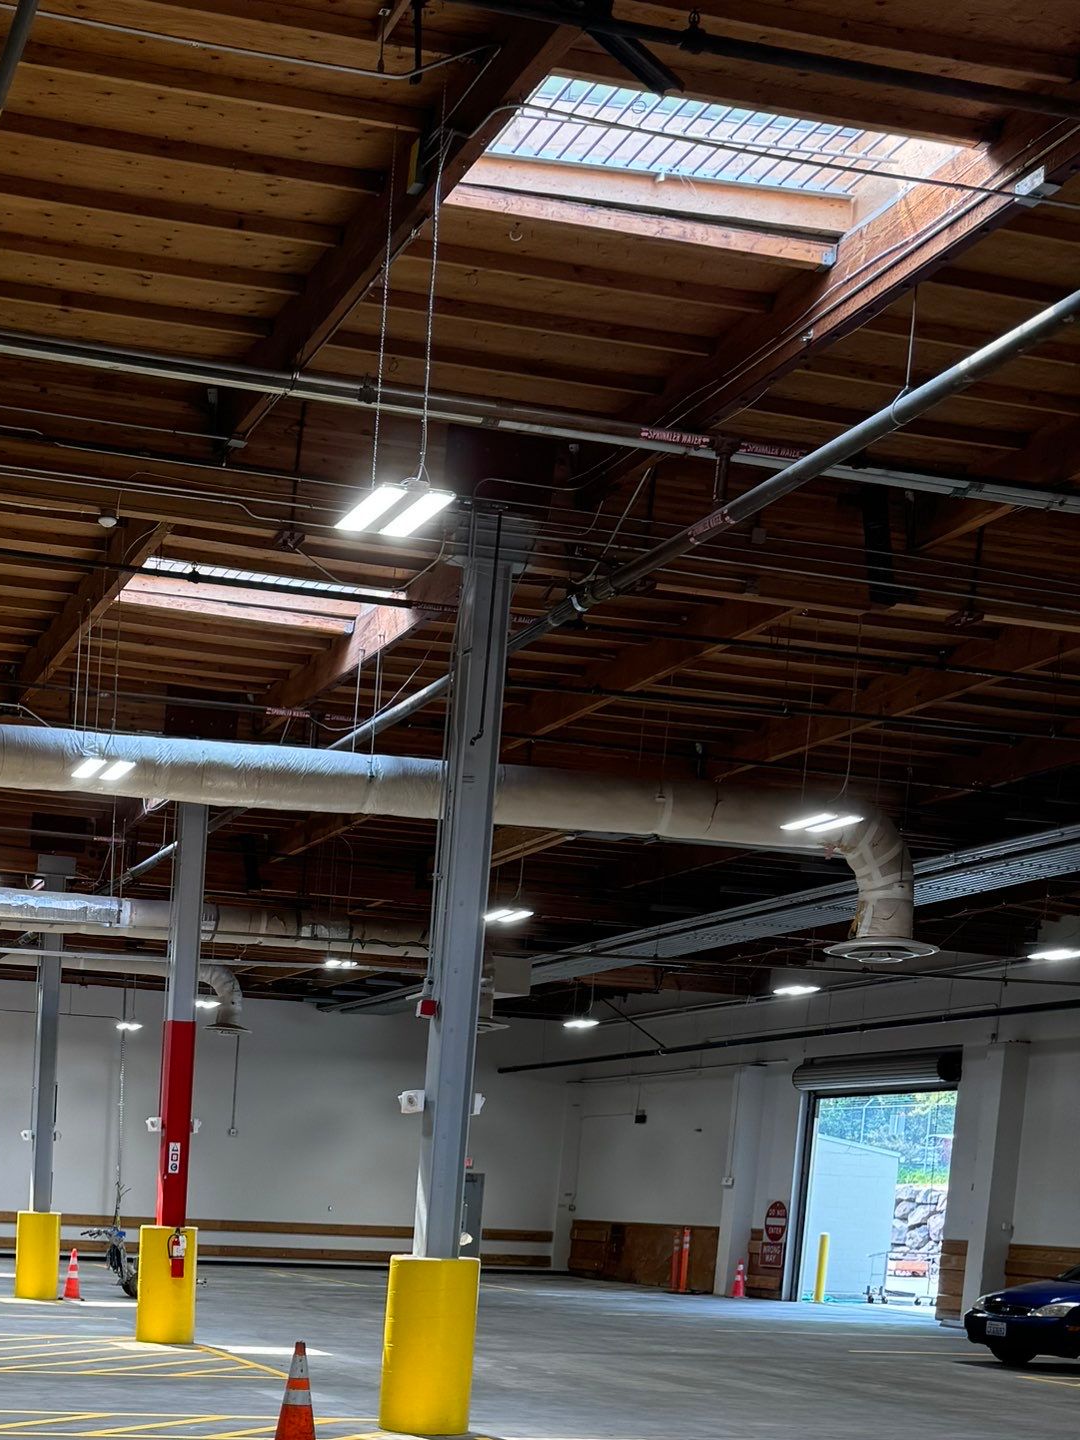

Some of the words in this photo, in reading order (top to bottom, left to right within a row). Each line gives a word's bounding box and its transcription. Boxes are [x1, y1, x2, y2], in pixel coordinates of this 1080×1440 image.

[648, 429, 681, 443] SPRINKLER
[680, 434, 703, 446] WATER
[769, 1208, 776, 1216] DO
[777, 1209, 786, 1217] NOT
[768, 1226, 782, 1235] ENTER
[763, 1245, 781, 1254] WRONG
[765, 1254, 778, 1263] WAY
